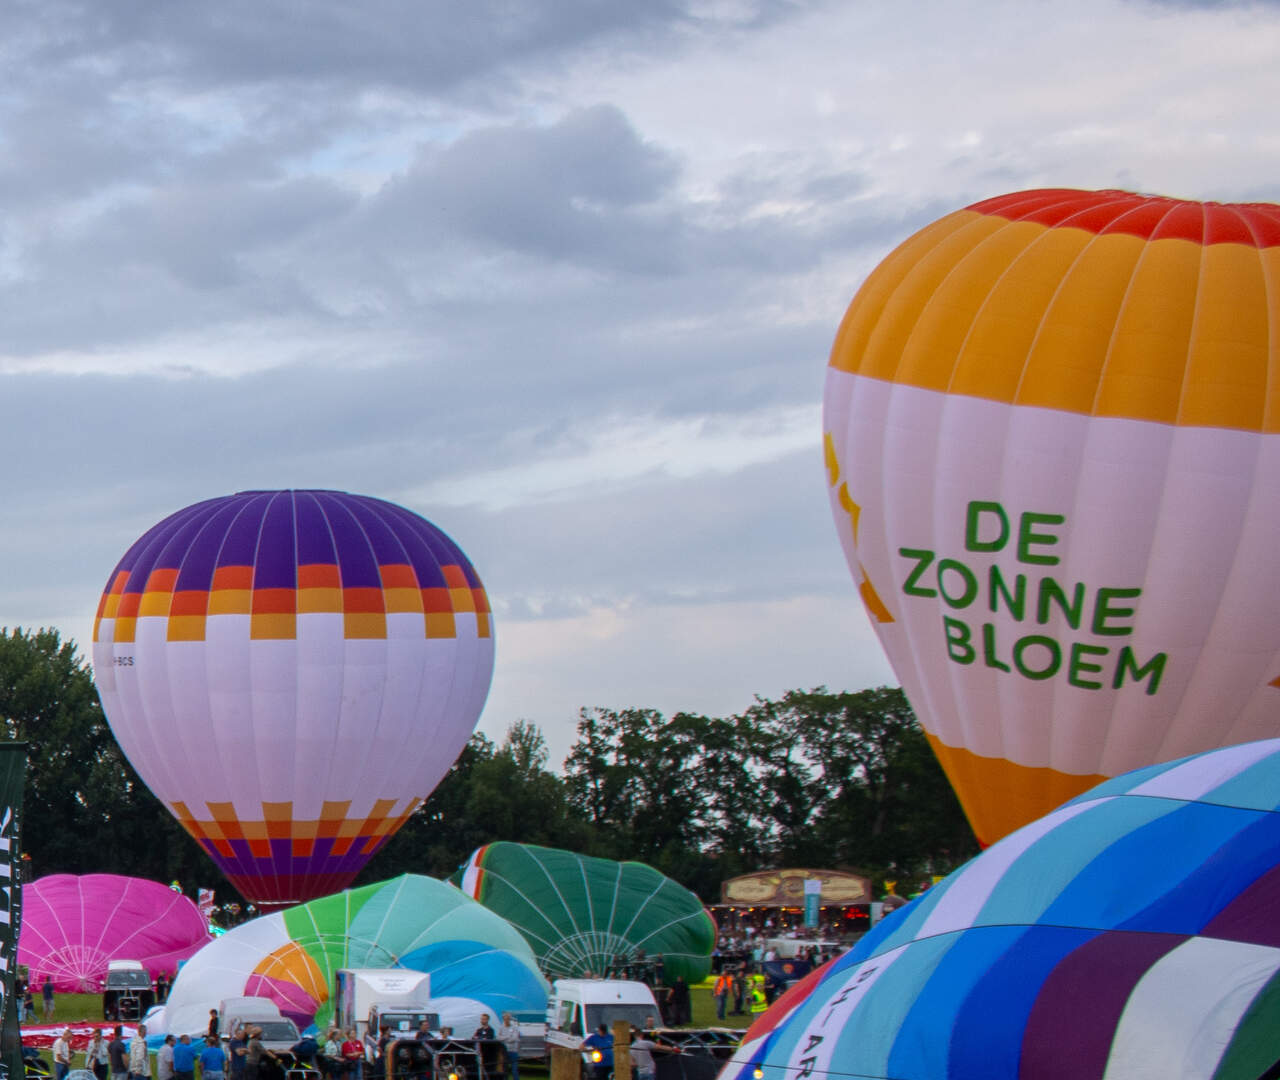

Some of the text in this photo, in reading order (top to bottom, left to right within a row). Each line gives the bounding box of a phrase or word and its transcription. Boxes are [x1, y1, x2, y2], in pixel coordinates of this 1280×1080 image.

[965, 501, 1066, 566] DE
[898, 547, 1142, 636] ZONNE
[943, 615, 1168, 696] BLOEM
